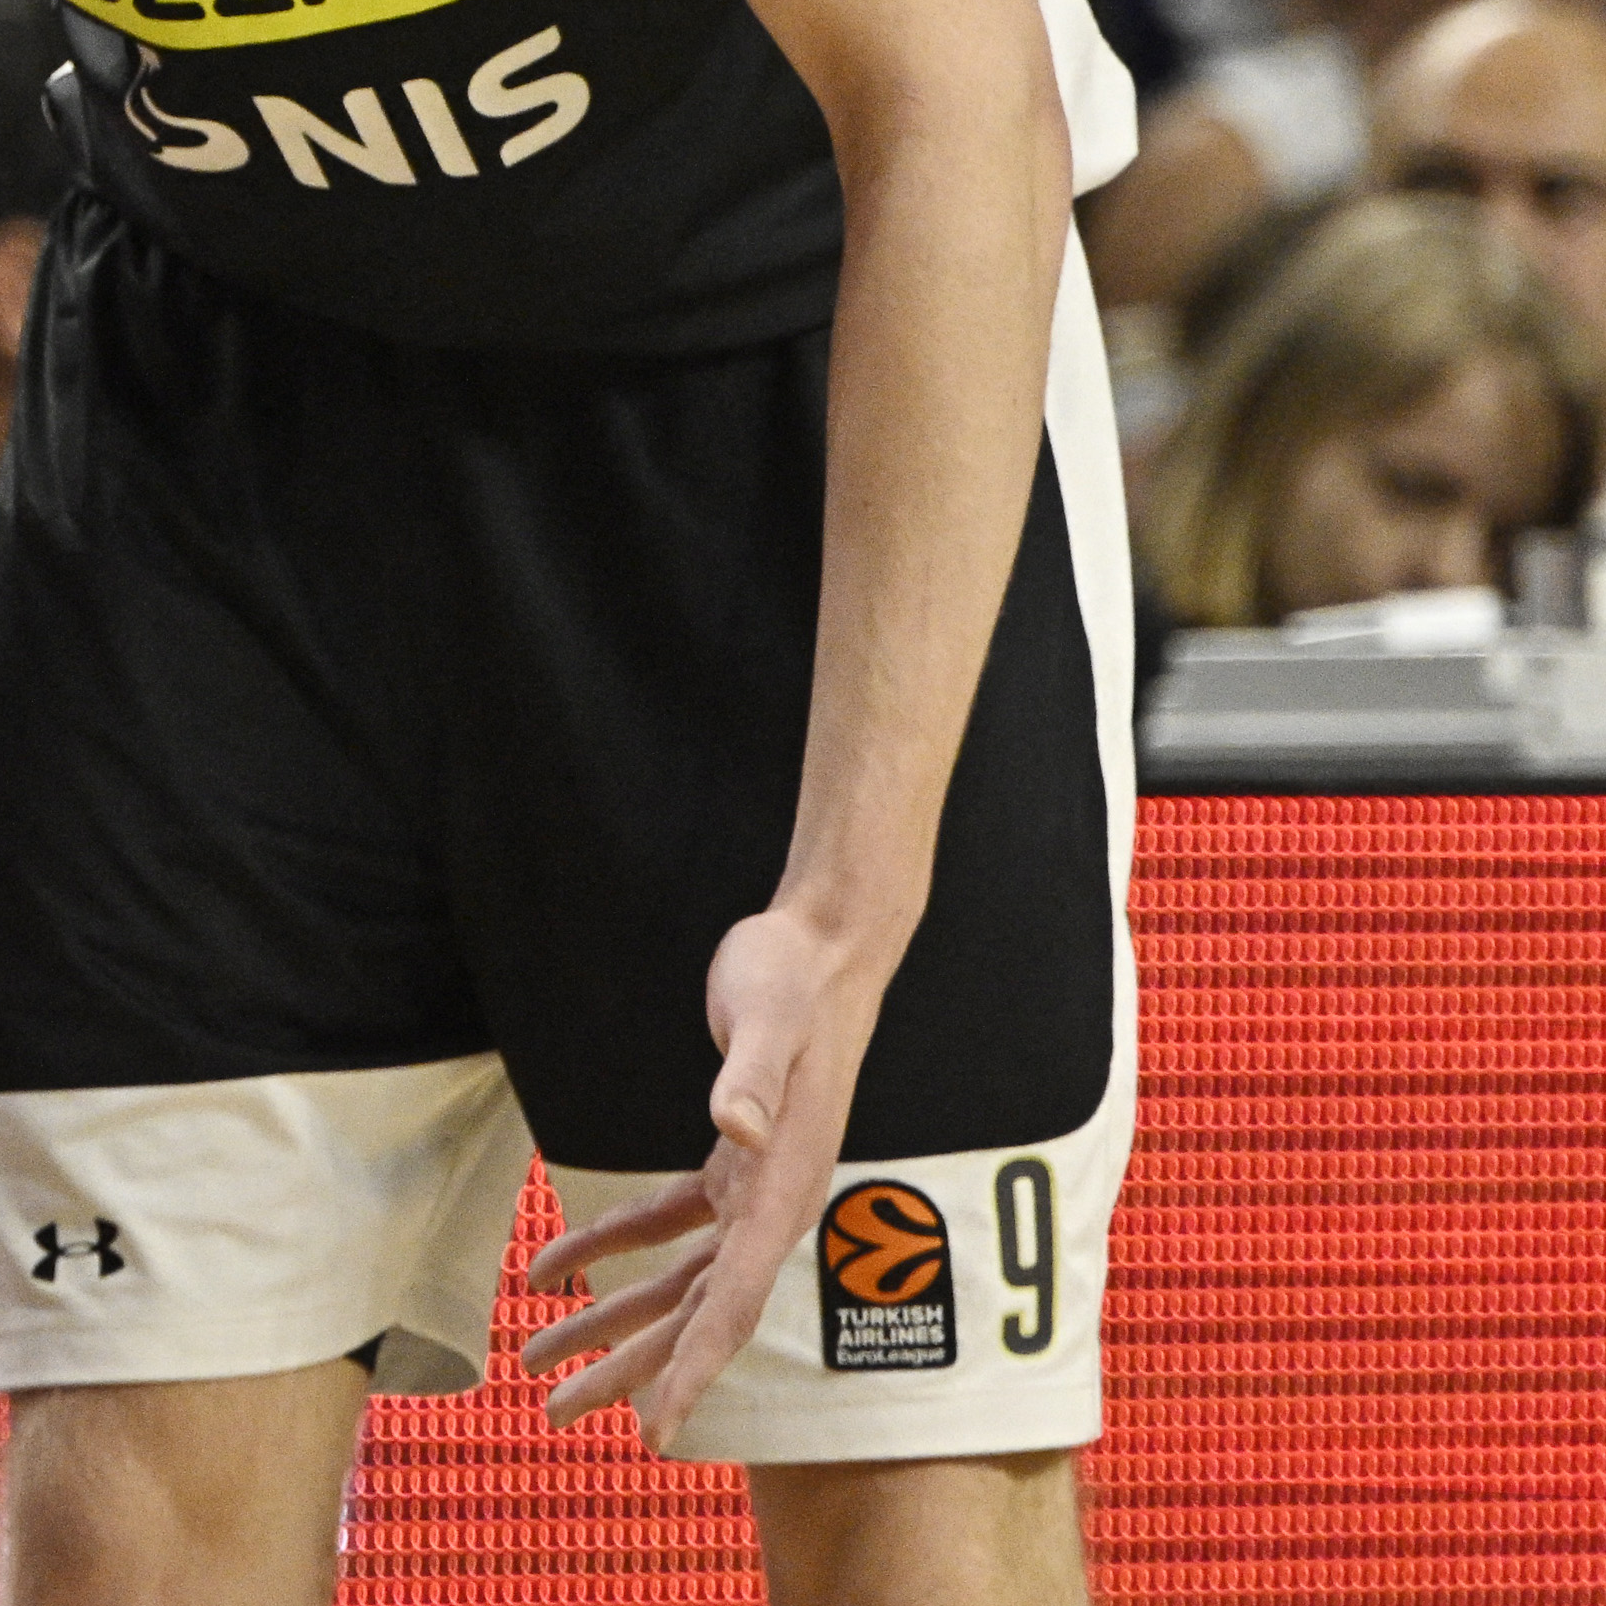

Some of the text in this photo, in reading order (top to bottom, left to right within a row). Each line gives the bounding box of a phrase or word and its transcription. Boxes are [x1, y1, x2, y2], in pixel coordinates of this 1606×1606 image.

[251, 25, 590, 189] NIS
[995, 1155, 1055, 1358] 9
[836, 1305, 944, 1326] TURKISH
[838, 1325, 945, 1345] AIRLINES
